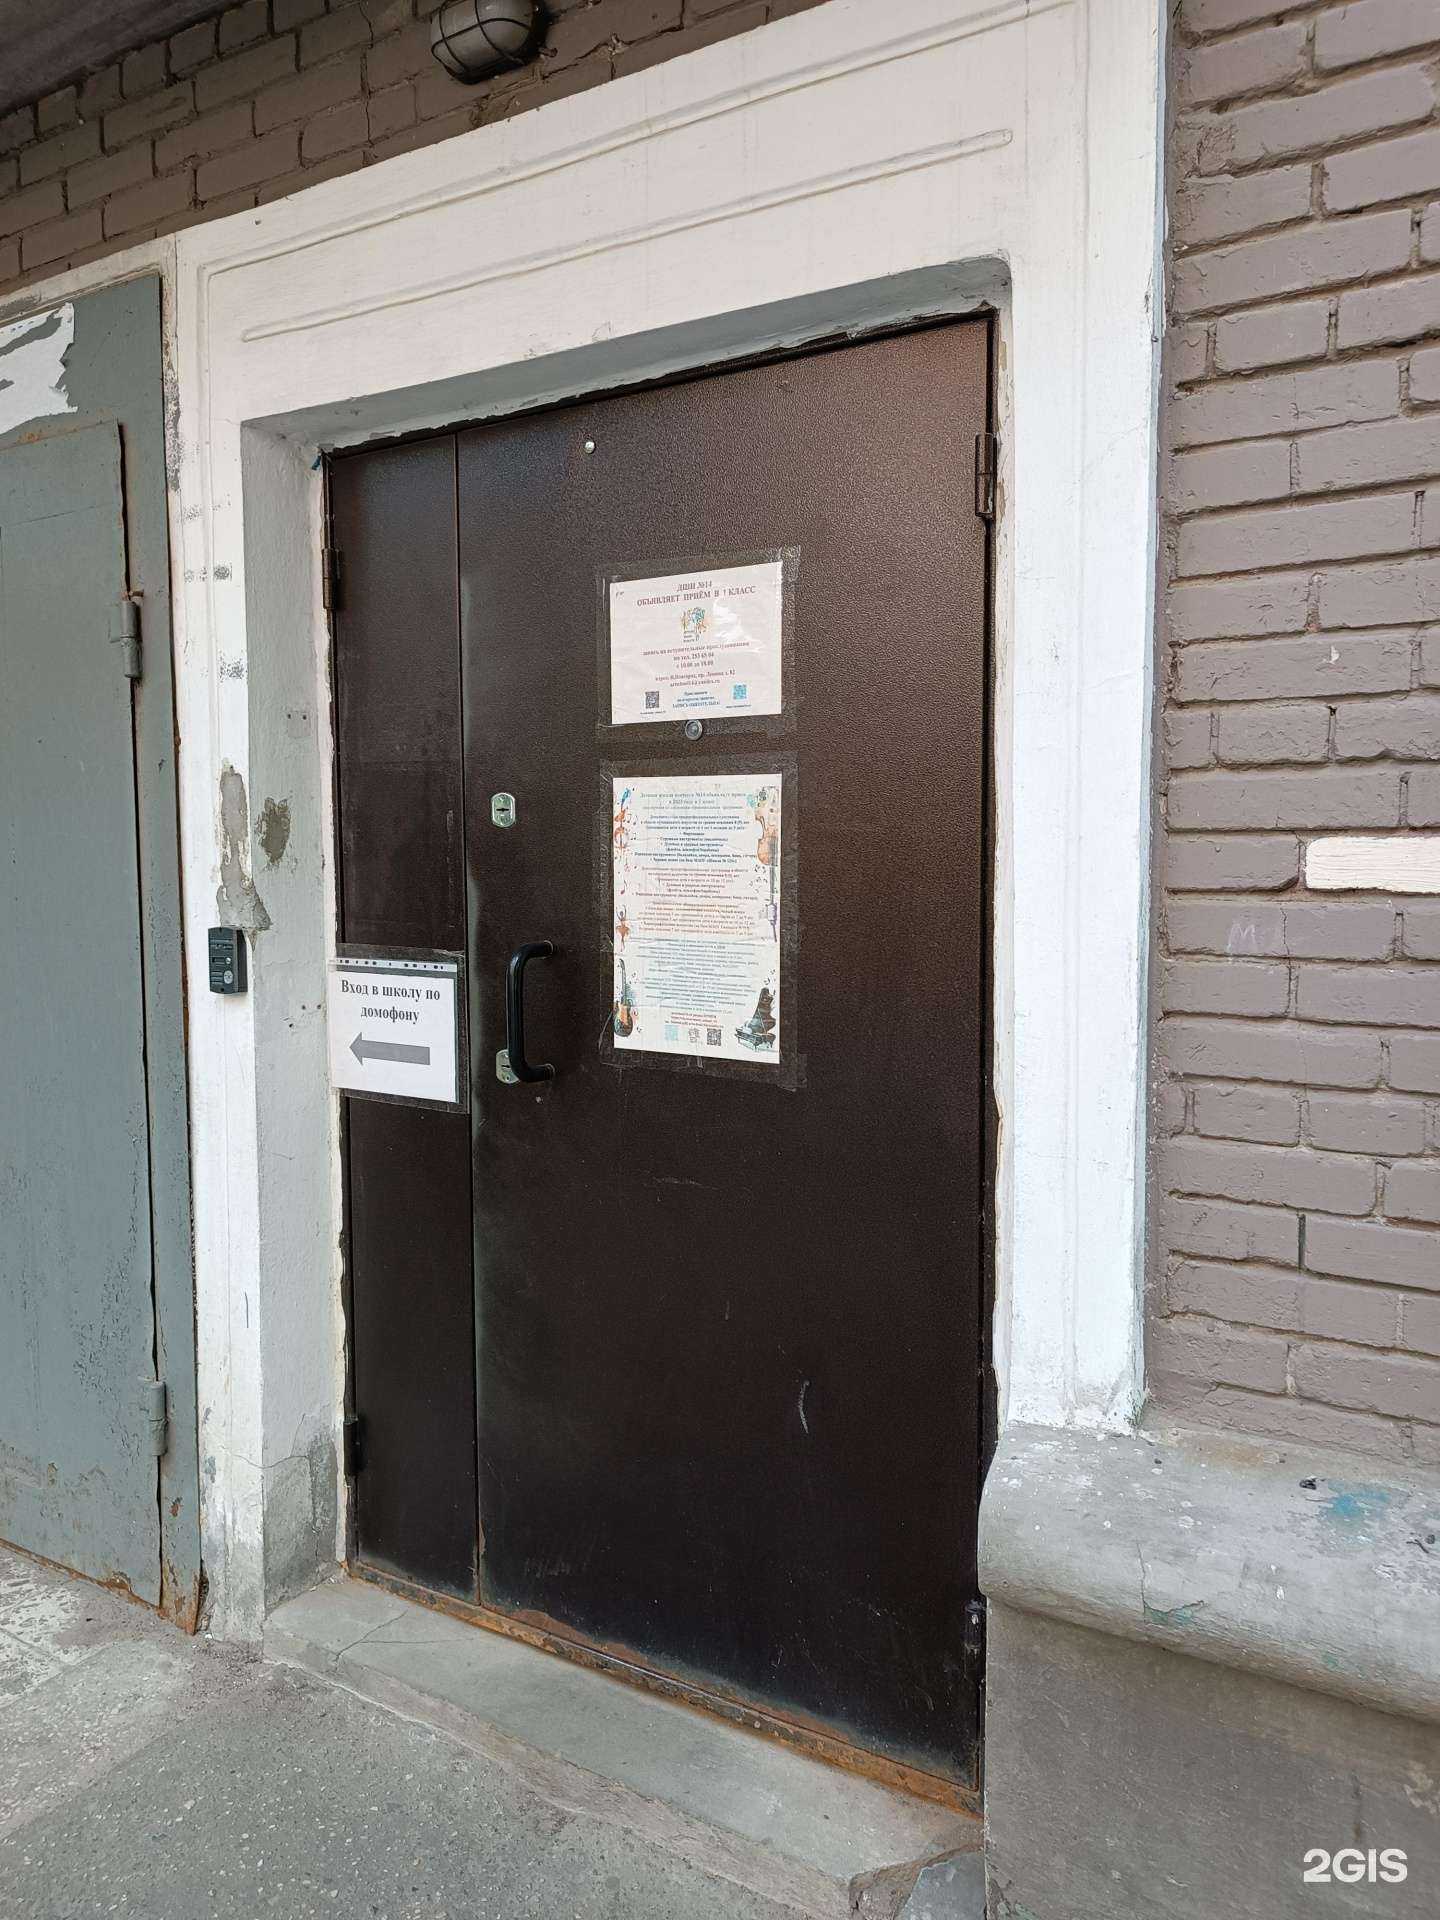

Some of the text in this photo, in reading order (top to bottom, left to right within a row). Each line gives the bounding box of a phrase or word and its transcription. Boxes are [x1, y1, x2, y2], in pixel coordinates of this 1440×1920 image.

[637, 595, 681, 606] ОБЪЯВЛЯЕТ
[714, 589, 719, 597] В
[728, 585, 756, 596] КЛАСС
[341, 979, 440, 1002] Вход в школу по
[360, 1006, 420, 1025] домофону
